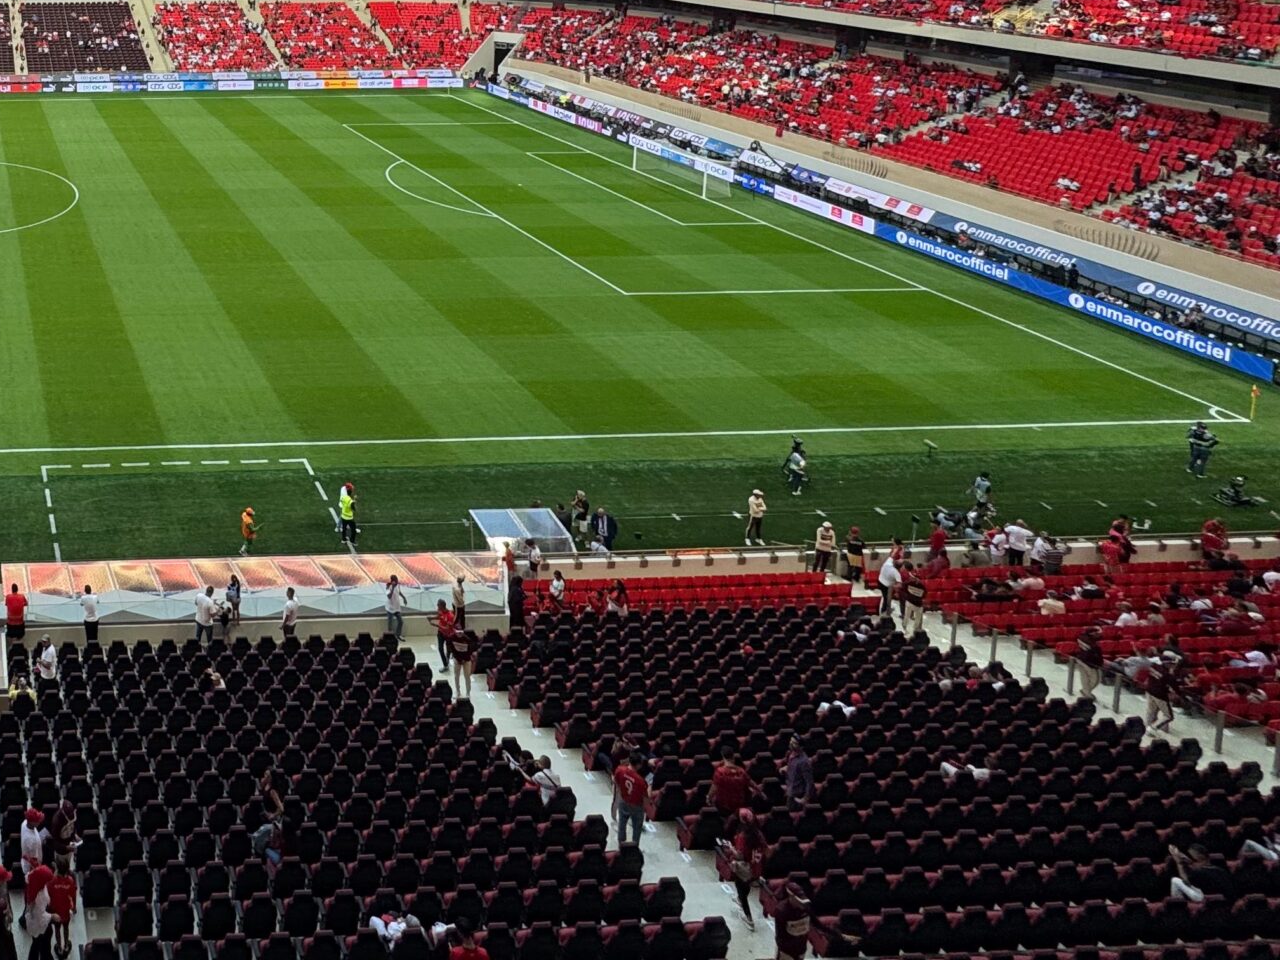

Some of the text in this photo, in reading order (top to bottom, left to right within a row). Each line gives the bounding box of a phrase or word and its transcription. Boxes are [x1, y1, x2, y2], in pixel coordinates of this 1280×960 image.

[711, 166, 727, 176] OCP
[909, 236, 1008, 280] enmarocofficiel
[968, 226, 1076, 268] enmarocofficiel
[1086, 300, 1231, 362] enmarocofficiel
[625, 780, 633, 795] 9
